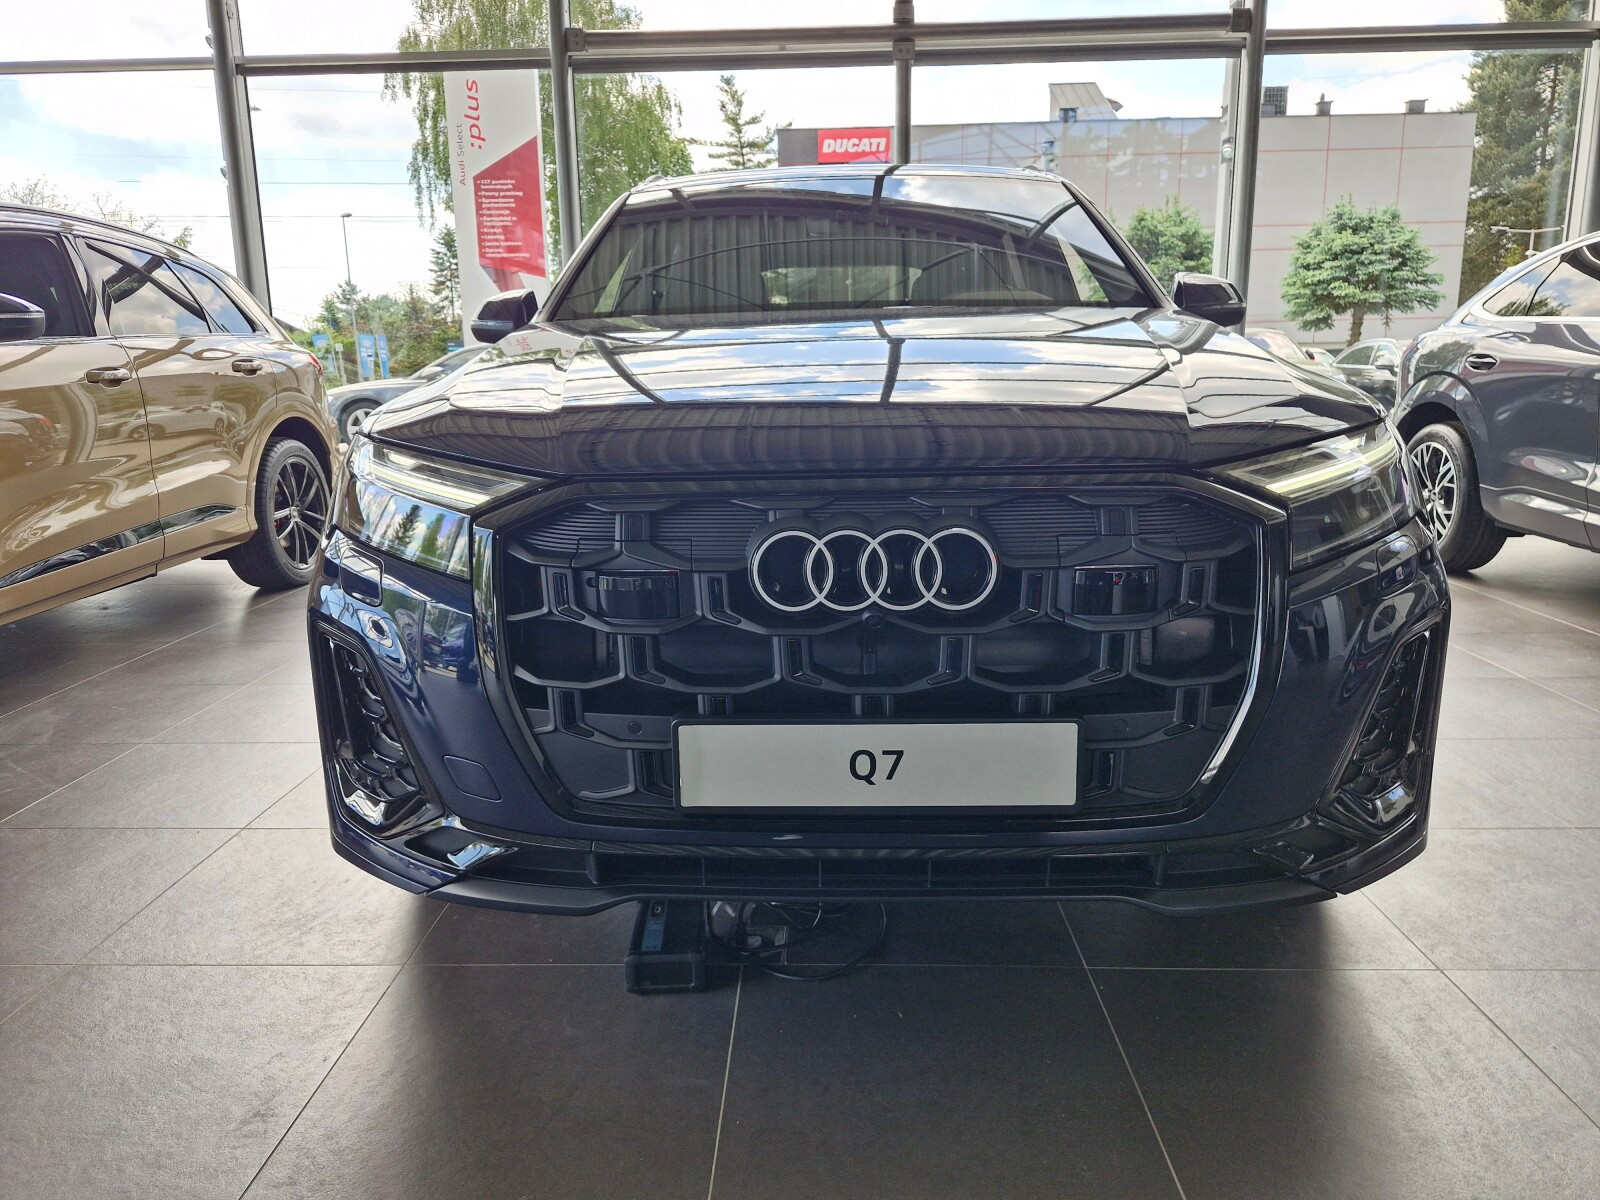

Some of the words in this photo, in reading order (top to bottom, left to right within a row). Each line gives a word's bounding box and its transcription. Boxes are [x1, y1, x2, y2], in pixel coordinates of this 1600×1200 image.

[464, 79, 486, 150] :plus
[456, 123, 464, 157] Select
[822, 137, 887, 153] DUCATI
[458, 160, 466, 185] Audi
[848, 748, 905, 785] Q7
